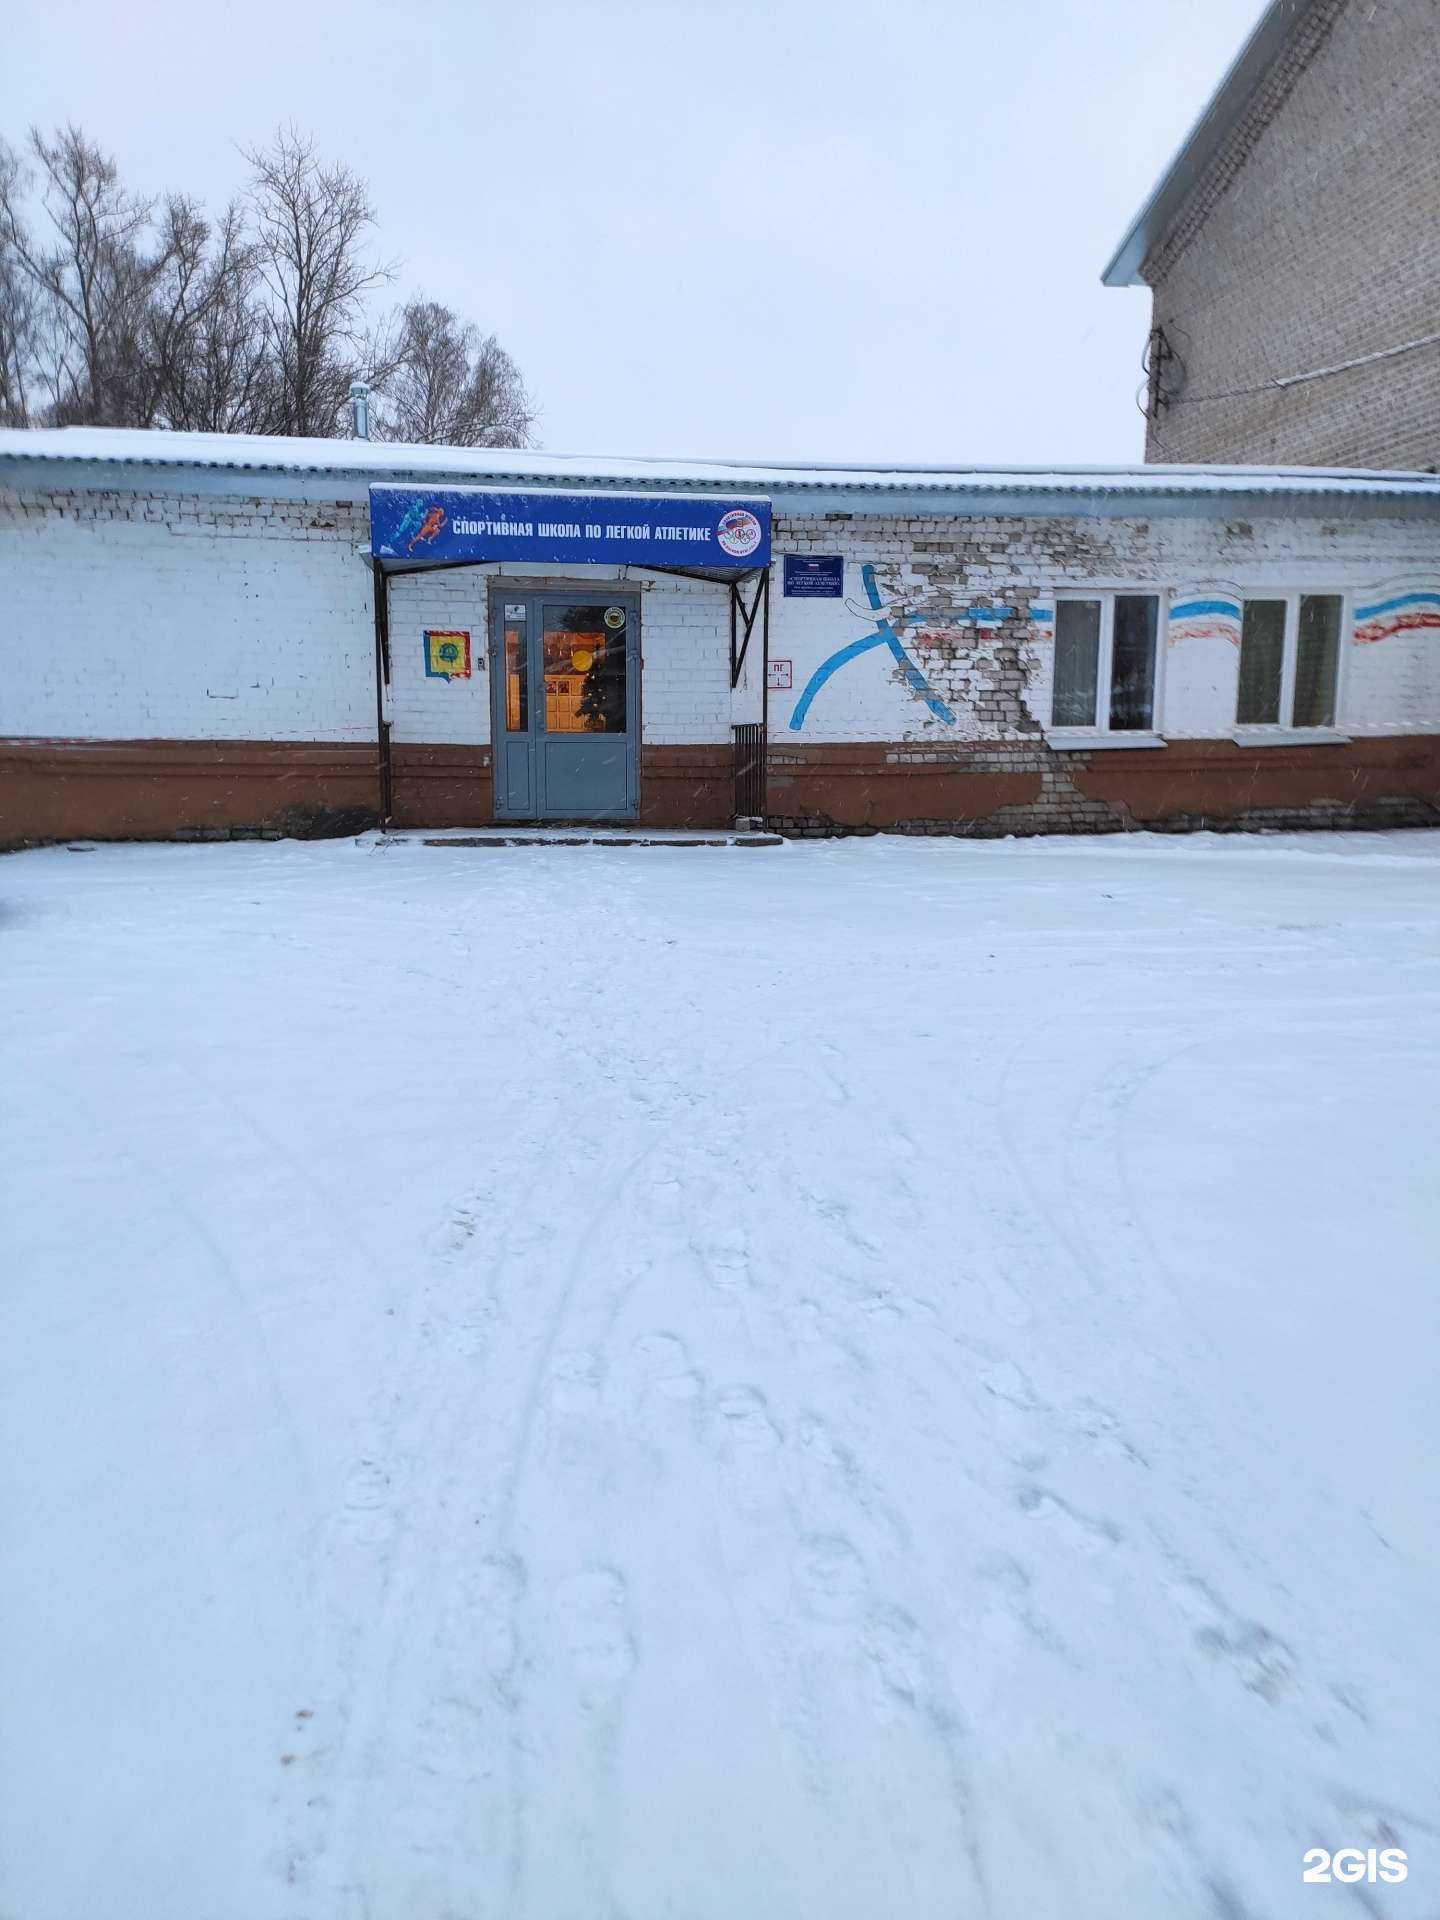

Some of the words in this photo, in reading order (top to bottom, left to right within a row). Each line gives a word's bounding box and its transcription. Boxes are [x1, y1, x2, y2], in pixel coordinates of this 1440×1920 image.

[453, 520, 533, 536] СПОРТИВНАЯ
[538, 523, 581, 538] ШКОЛА
[585, 524, 601, 538] ПО
[605, 524, 650, 540] ЛЕГКОЙ
[654, 527, 711, 541] АТЛЕТИКЕ
